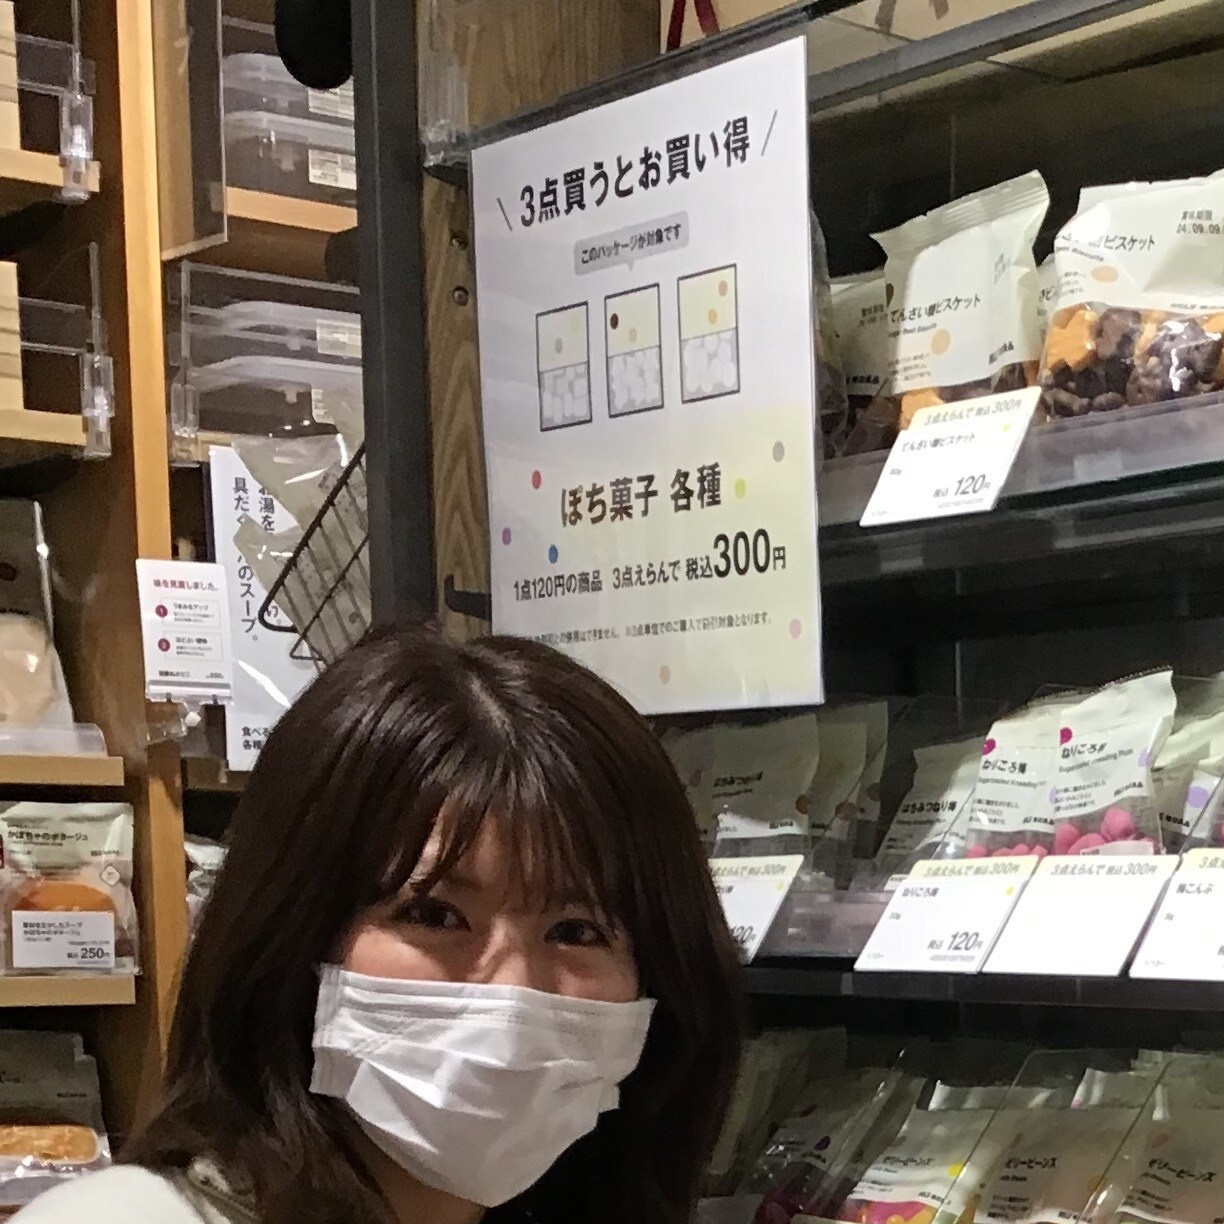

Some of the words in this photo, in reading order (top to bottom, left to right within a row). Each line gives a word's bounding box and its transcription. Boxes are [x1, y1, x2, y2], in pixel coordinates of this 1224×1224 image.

[520, 116, 750, 228] 3点買うとお買い得
[670, 461, 722, 514] 各種
[954, 474, 991, 497] 120円
[513, 569, 603, 603] 1点120円の商品
[612, 561, 681, 590] 3点えらんで
[685, 528, 787, 582] 税込300円
[947, 931, 984, 951] 120円
